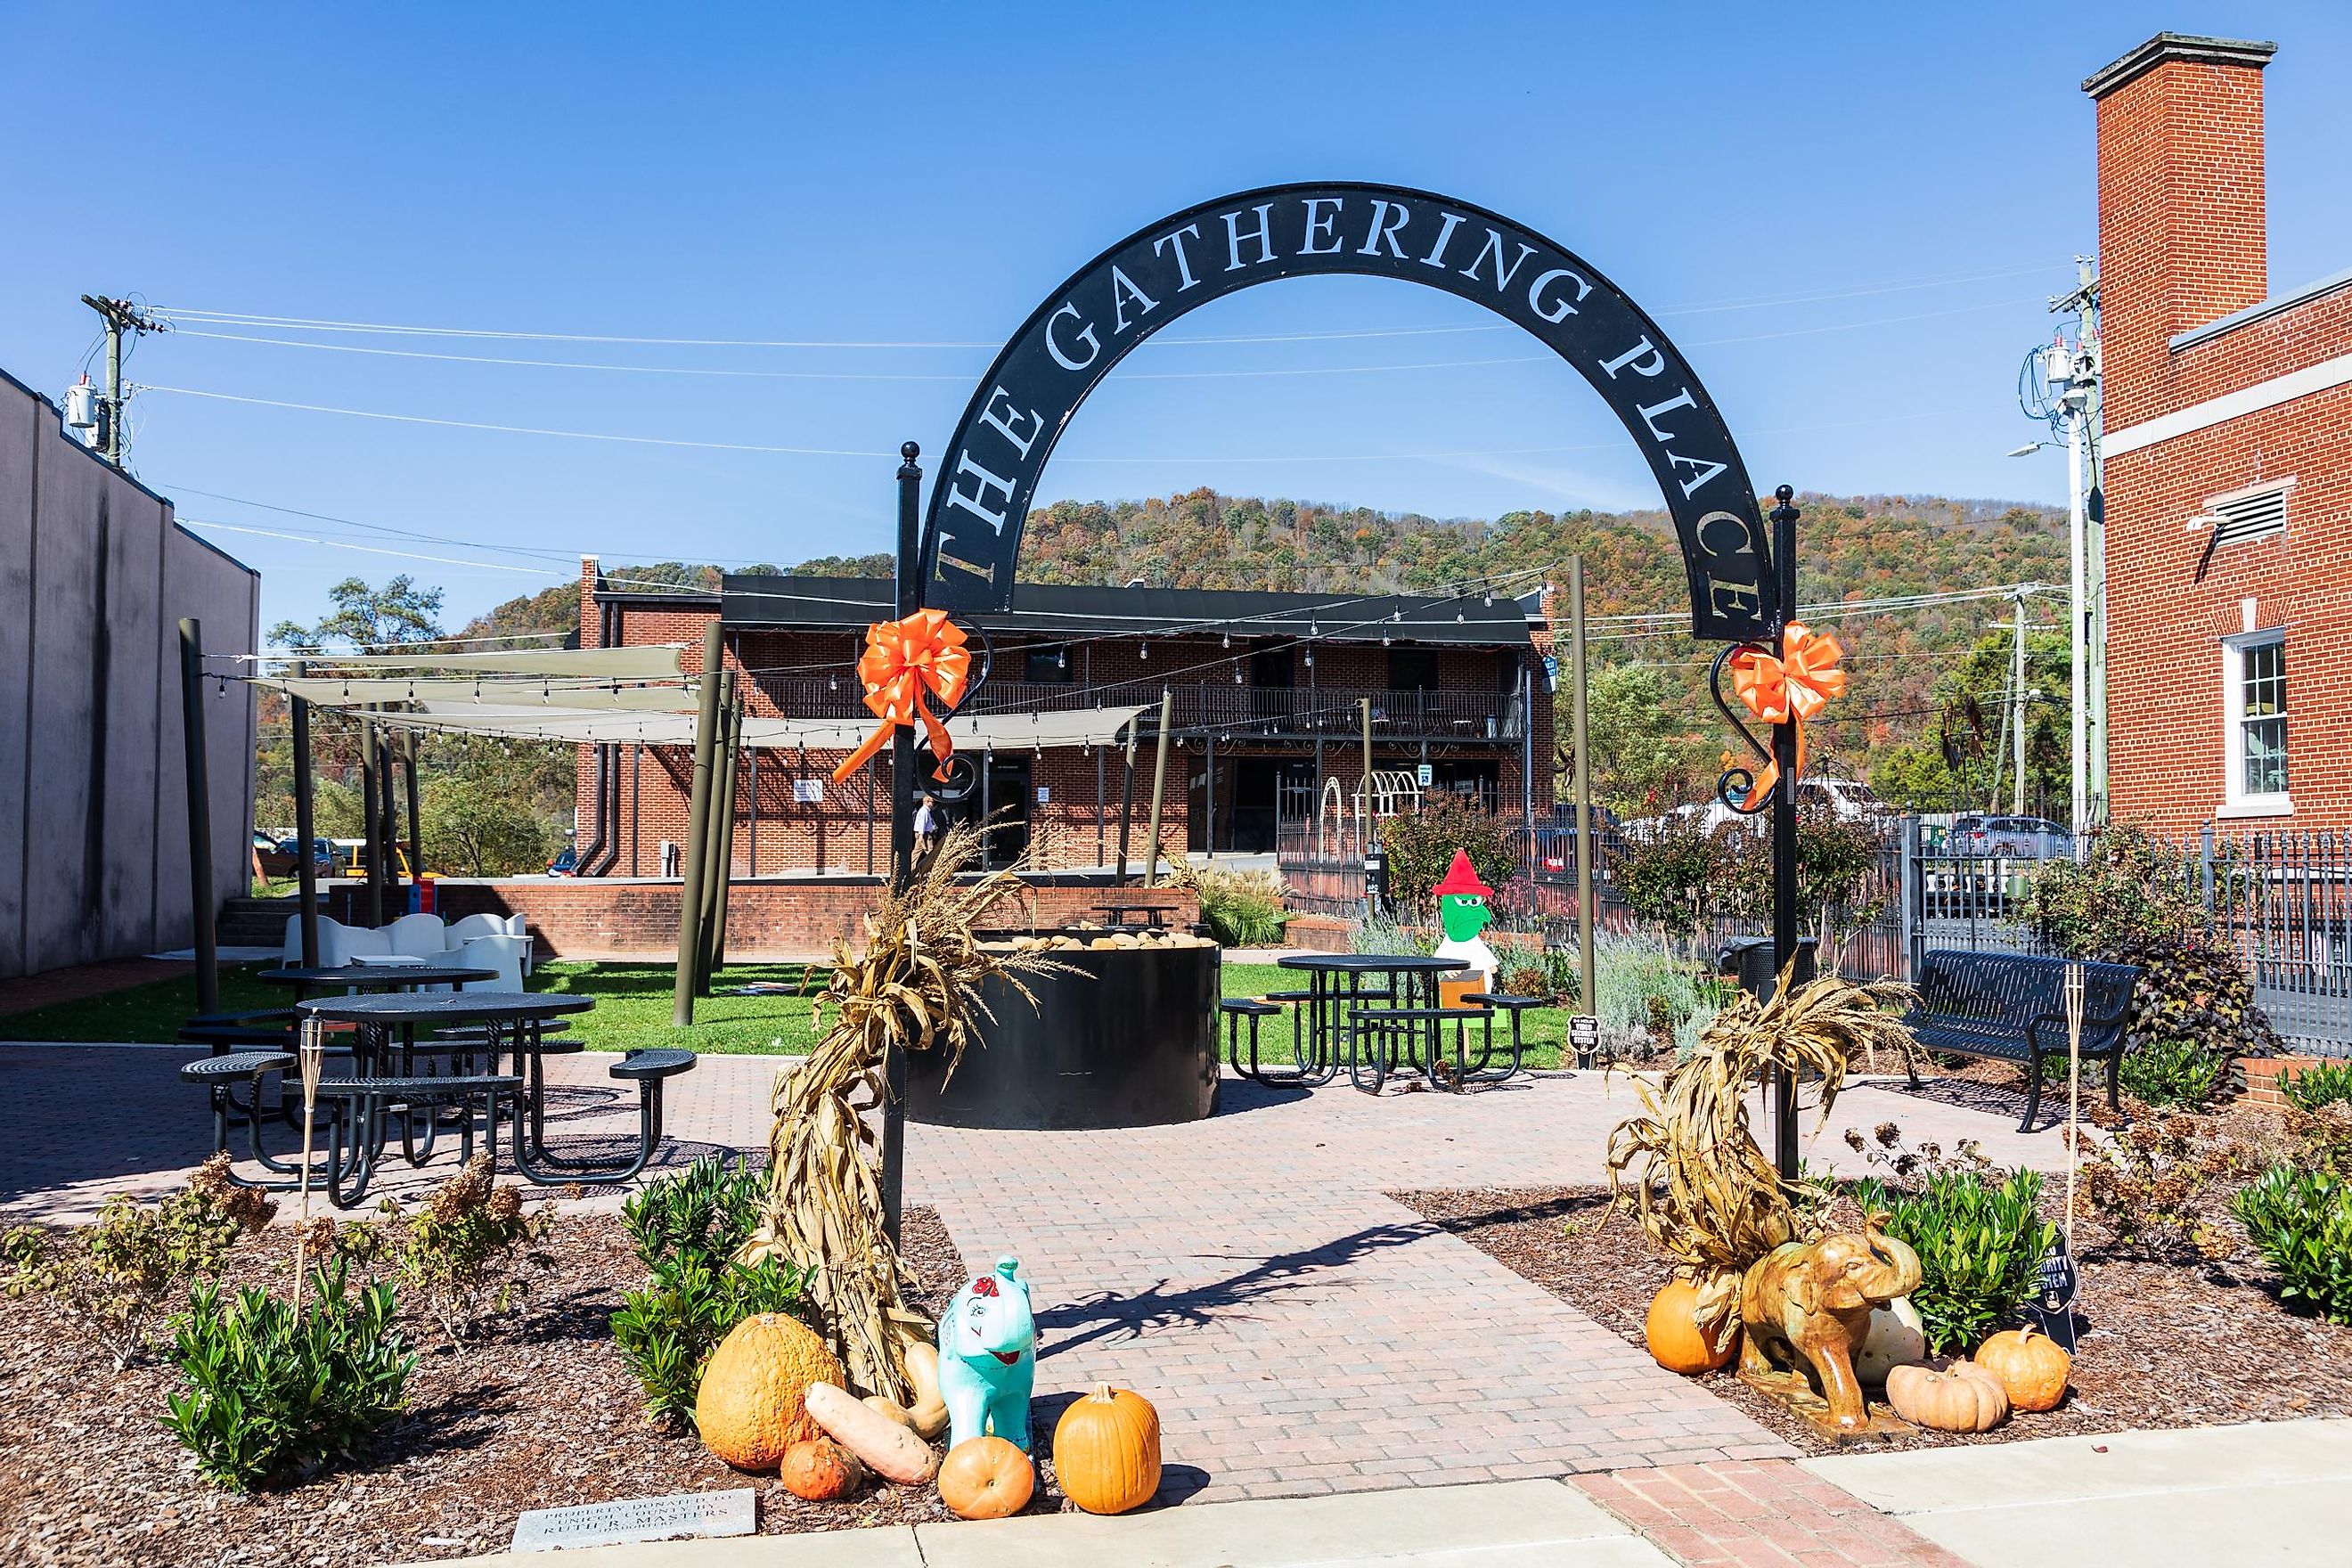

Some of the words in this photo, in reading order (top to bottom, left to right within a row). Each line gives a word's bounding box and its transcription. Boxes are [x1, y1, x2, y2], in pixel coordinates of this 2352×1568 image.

[935, 385, 1045, 590] THE
[1044, 198, 1594, 371] GATHERING
[1597, 334, 1763, 622] PLACE
[1571, 1030, 1597, 1038] SECURITY
[2040, 1255, 2068, 1273] URITY
[544, 1506, 625, 1520] PROPERTY
[633, 1498, 706, 1509] DONATED
[625, 1506, 689, 1518] COUNTY
[544, 1523, 598, 1534] RUTH
[636, 1508, 728, 1523] MASTERS
